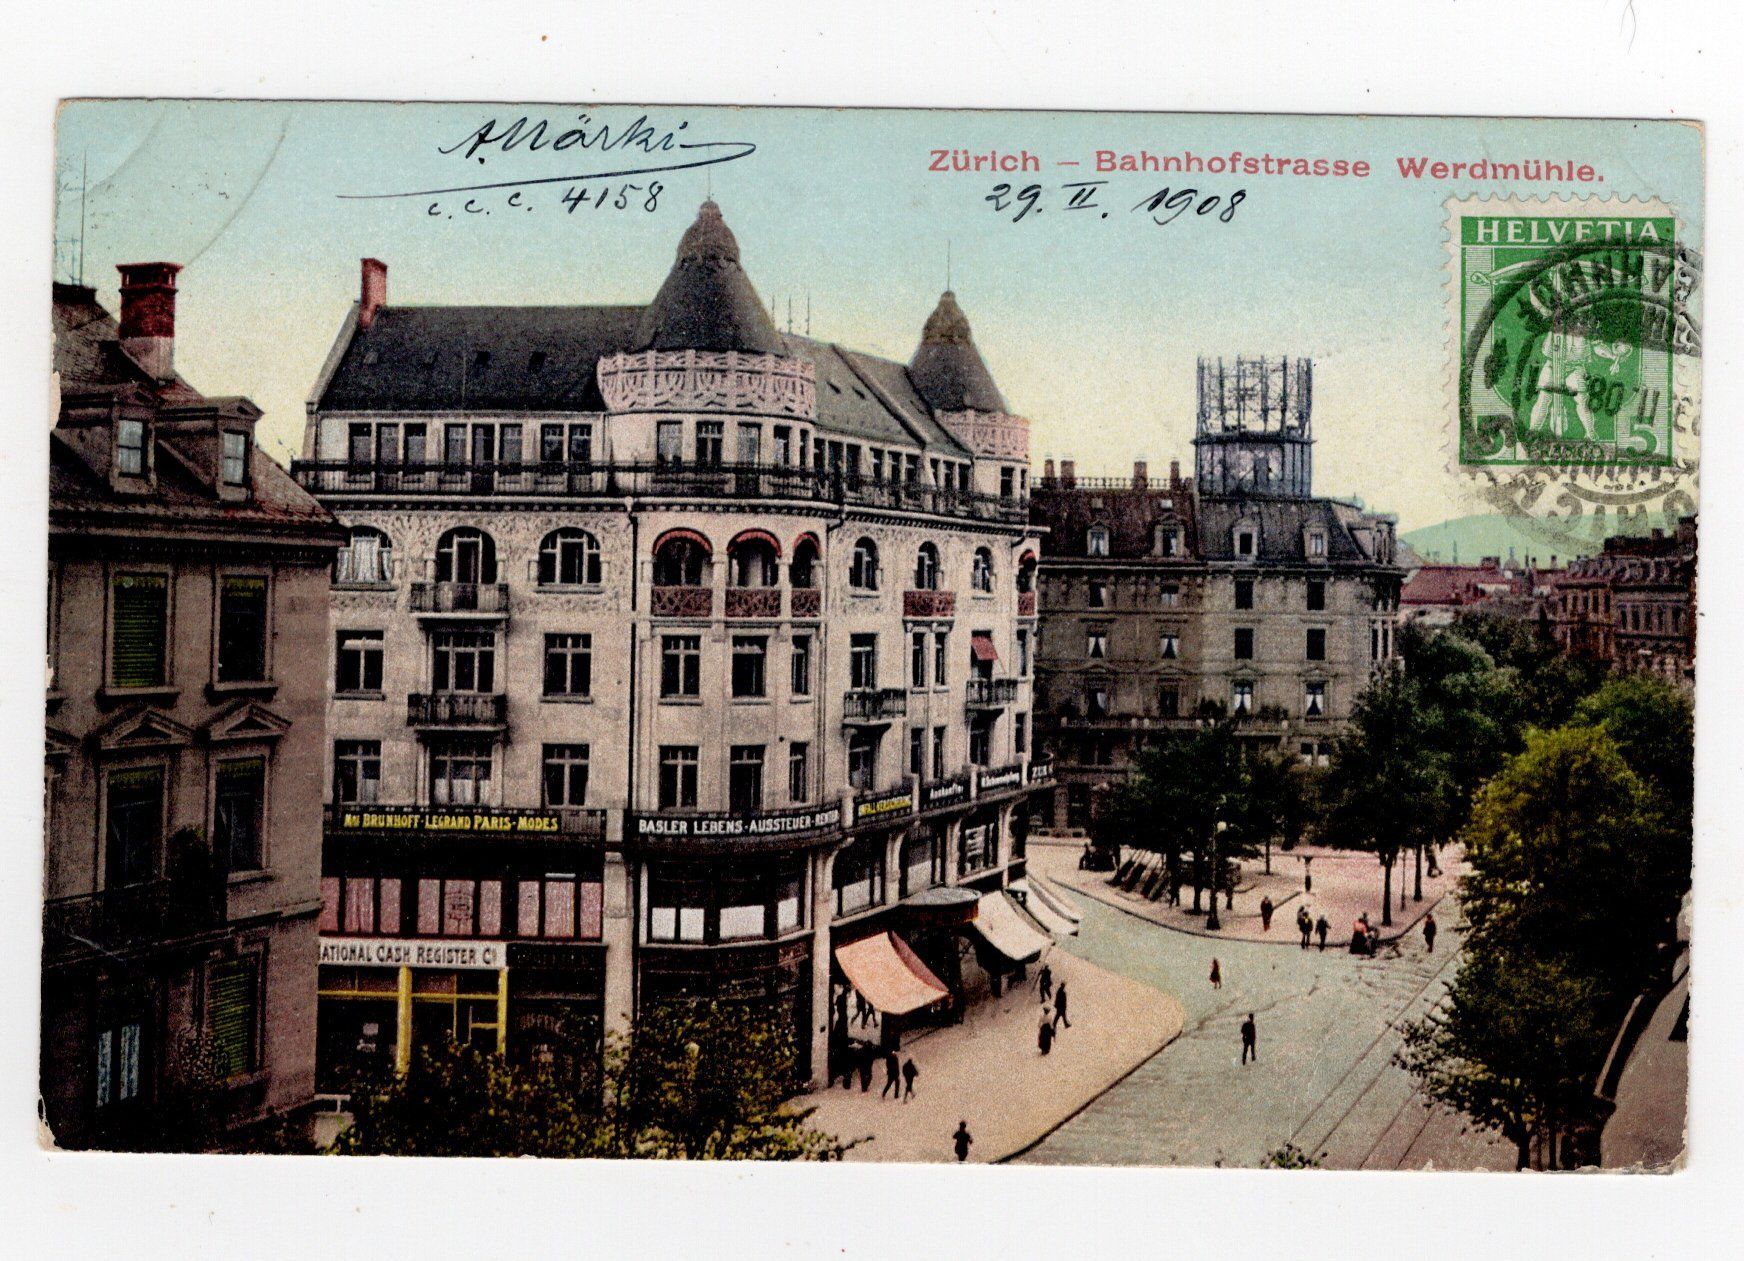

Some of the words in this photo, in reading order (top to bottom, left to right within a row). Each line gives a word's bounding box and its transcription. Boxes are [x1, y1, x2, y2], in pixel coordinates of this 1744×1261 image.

[561, 180, 665, 215] 4158
[1131, 186, 1248, 226] 1908
[1475, 218, 1662, 244] HELVETIA
[1626, 414, 1658, 459] 5
[638, 819, 688, 834] BASLER
[318, 944, 373, 962] ATIONAL
[376, 945, 411, 963] CASH
[416, 946, 477, 965] REGISTER
